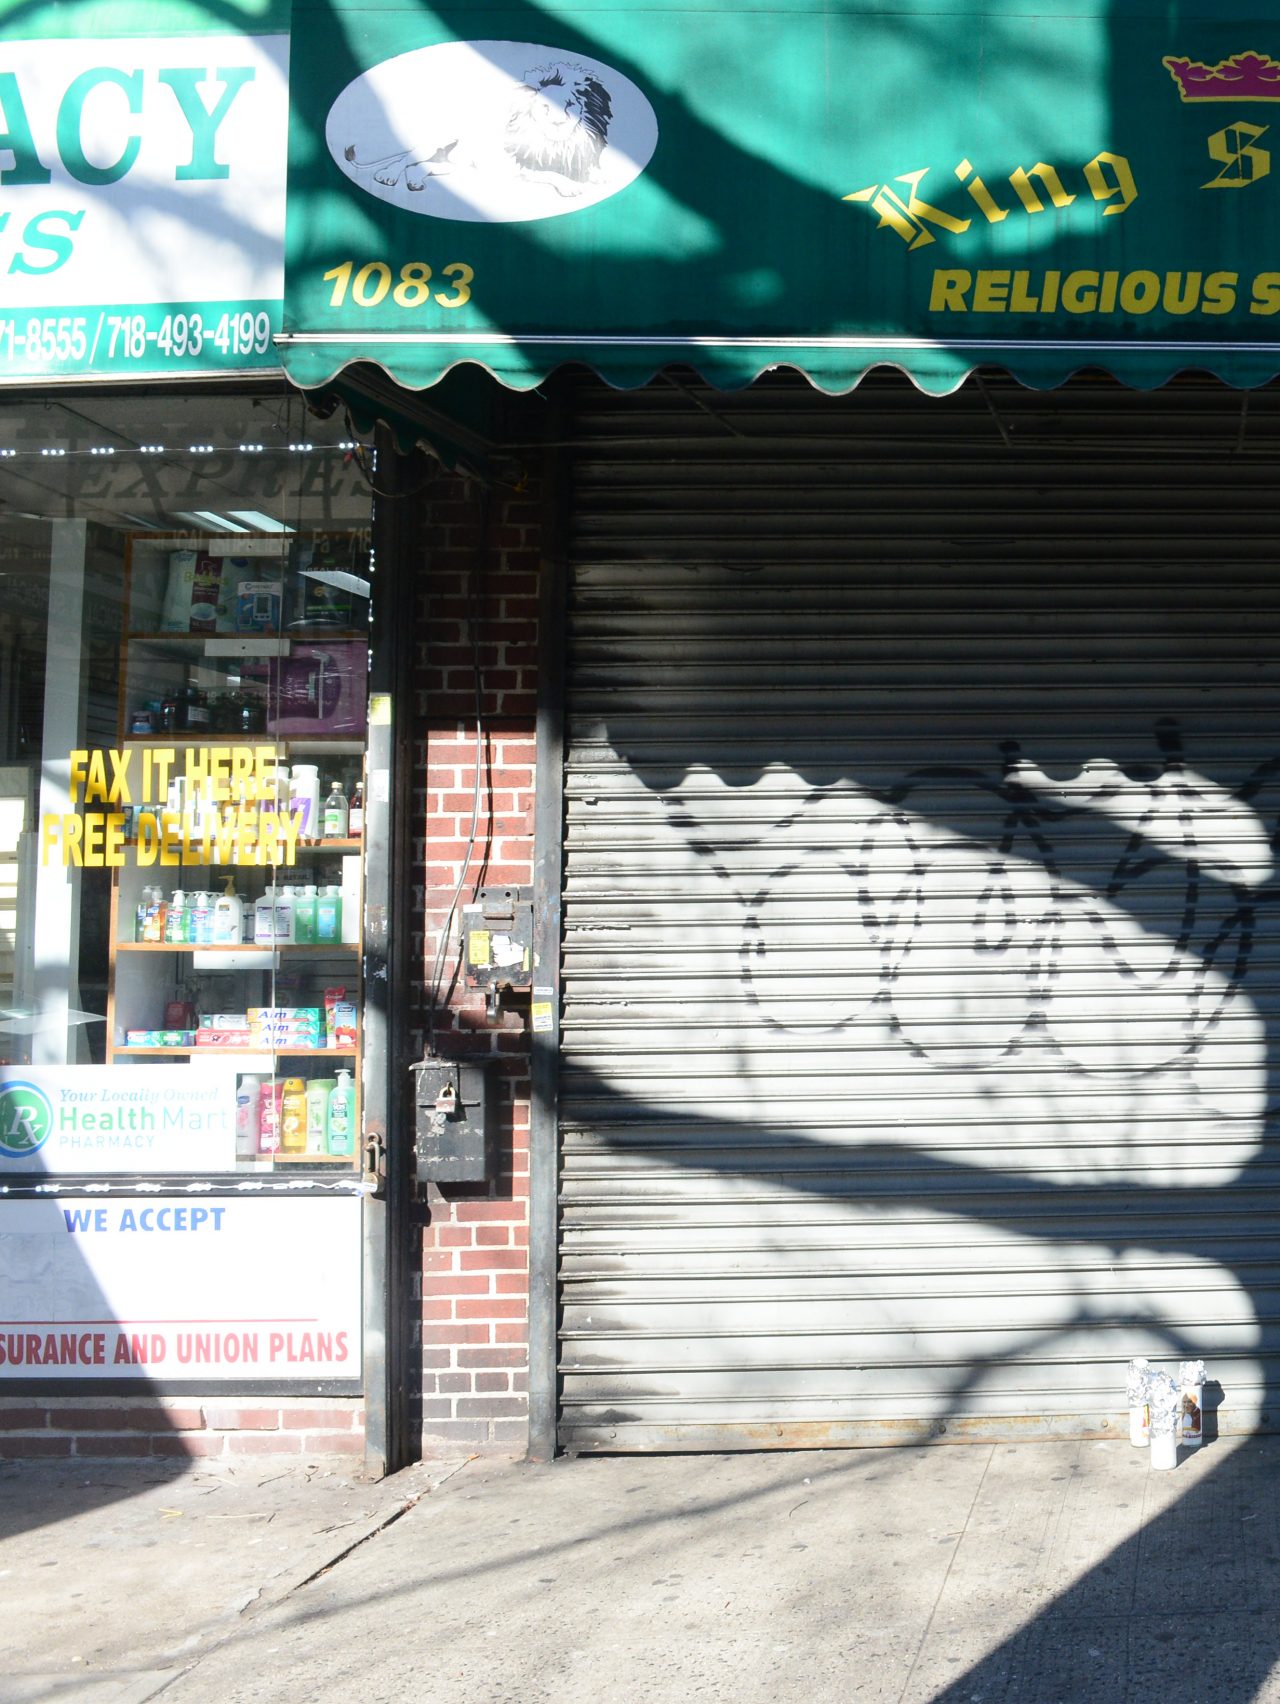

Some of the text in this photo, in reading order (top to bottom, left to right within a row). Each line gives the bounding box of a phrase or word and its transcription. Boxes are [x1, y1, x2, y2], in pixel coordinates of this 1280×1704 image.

[842, 152, 1138, 251] King
[0, 209, 86, 276] S
[323, 262, 473, 307] 1083
[930, 269, 1237, 314] RELIGIOUS
[69, 746, 277, 803] FAX IT HERE
[41, 811, 304, 867] FREE DELIVERY
[58, 1088, 98, 1103] Your
[59, 1106, 229, 1131] Health Mart
[59, 1135, 155, 1149] PHARMACY
[66, 1207, 226, 1232] WE ACCEPT
[113, 1333, 167, 1365] AND
[176, 1332, 259, 1364] UNION
[269, 1330, 349, 1363] PLANS
